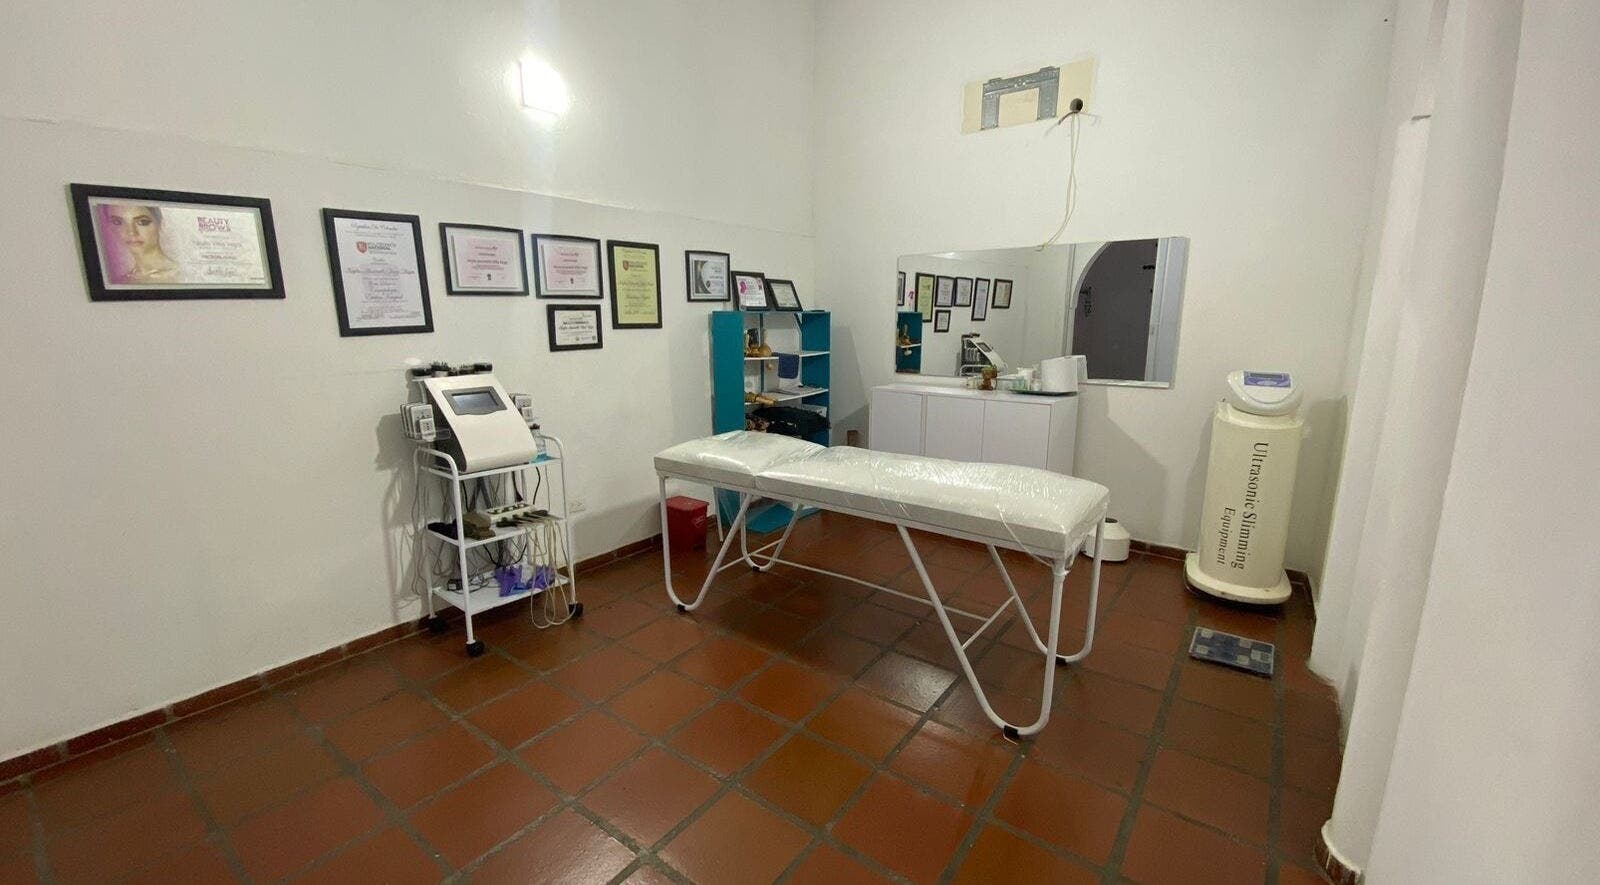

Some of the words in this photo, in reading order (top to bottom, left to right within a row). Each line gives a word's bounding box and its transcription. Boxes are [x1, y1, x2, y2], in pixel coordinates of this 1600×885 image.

[197, 216, 229, 225] BEAUTY
[1244, 442, 1269, 510] Ultrasonic
[1216, 507, 1236, 565] Equipment
[1231, 511, 1258, 569] Slimming
